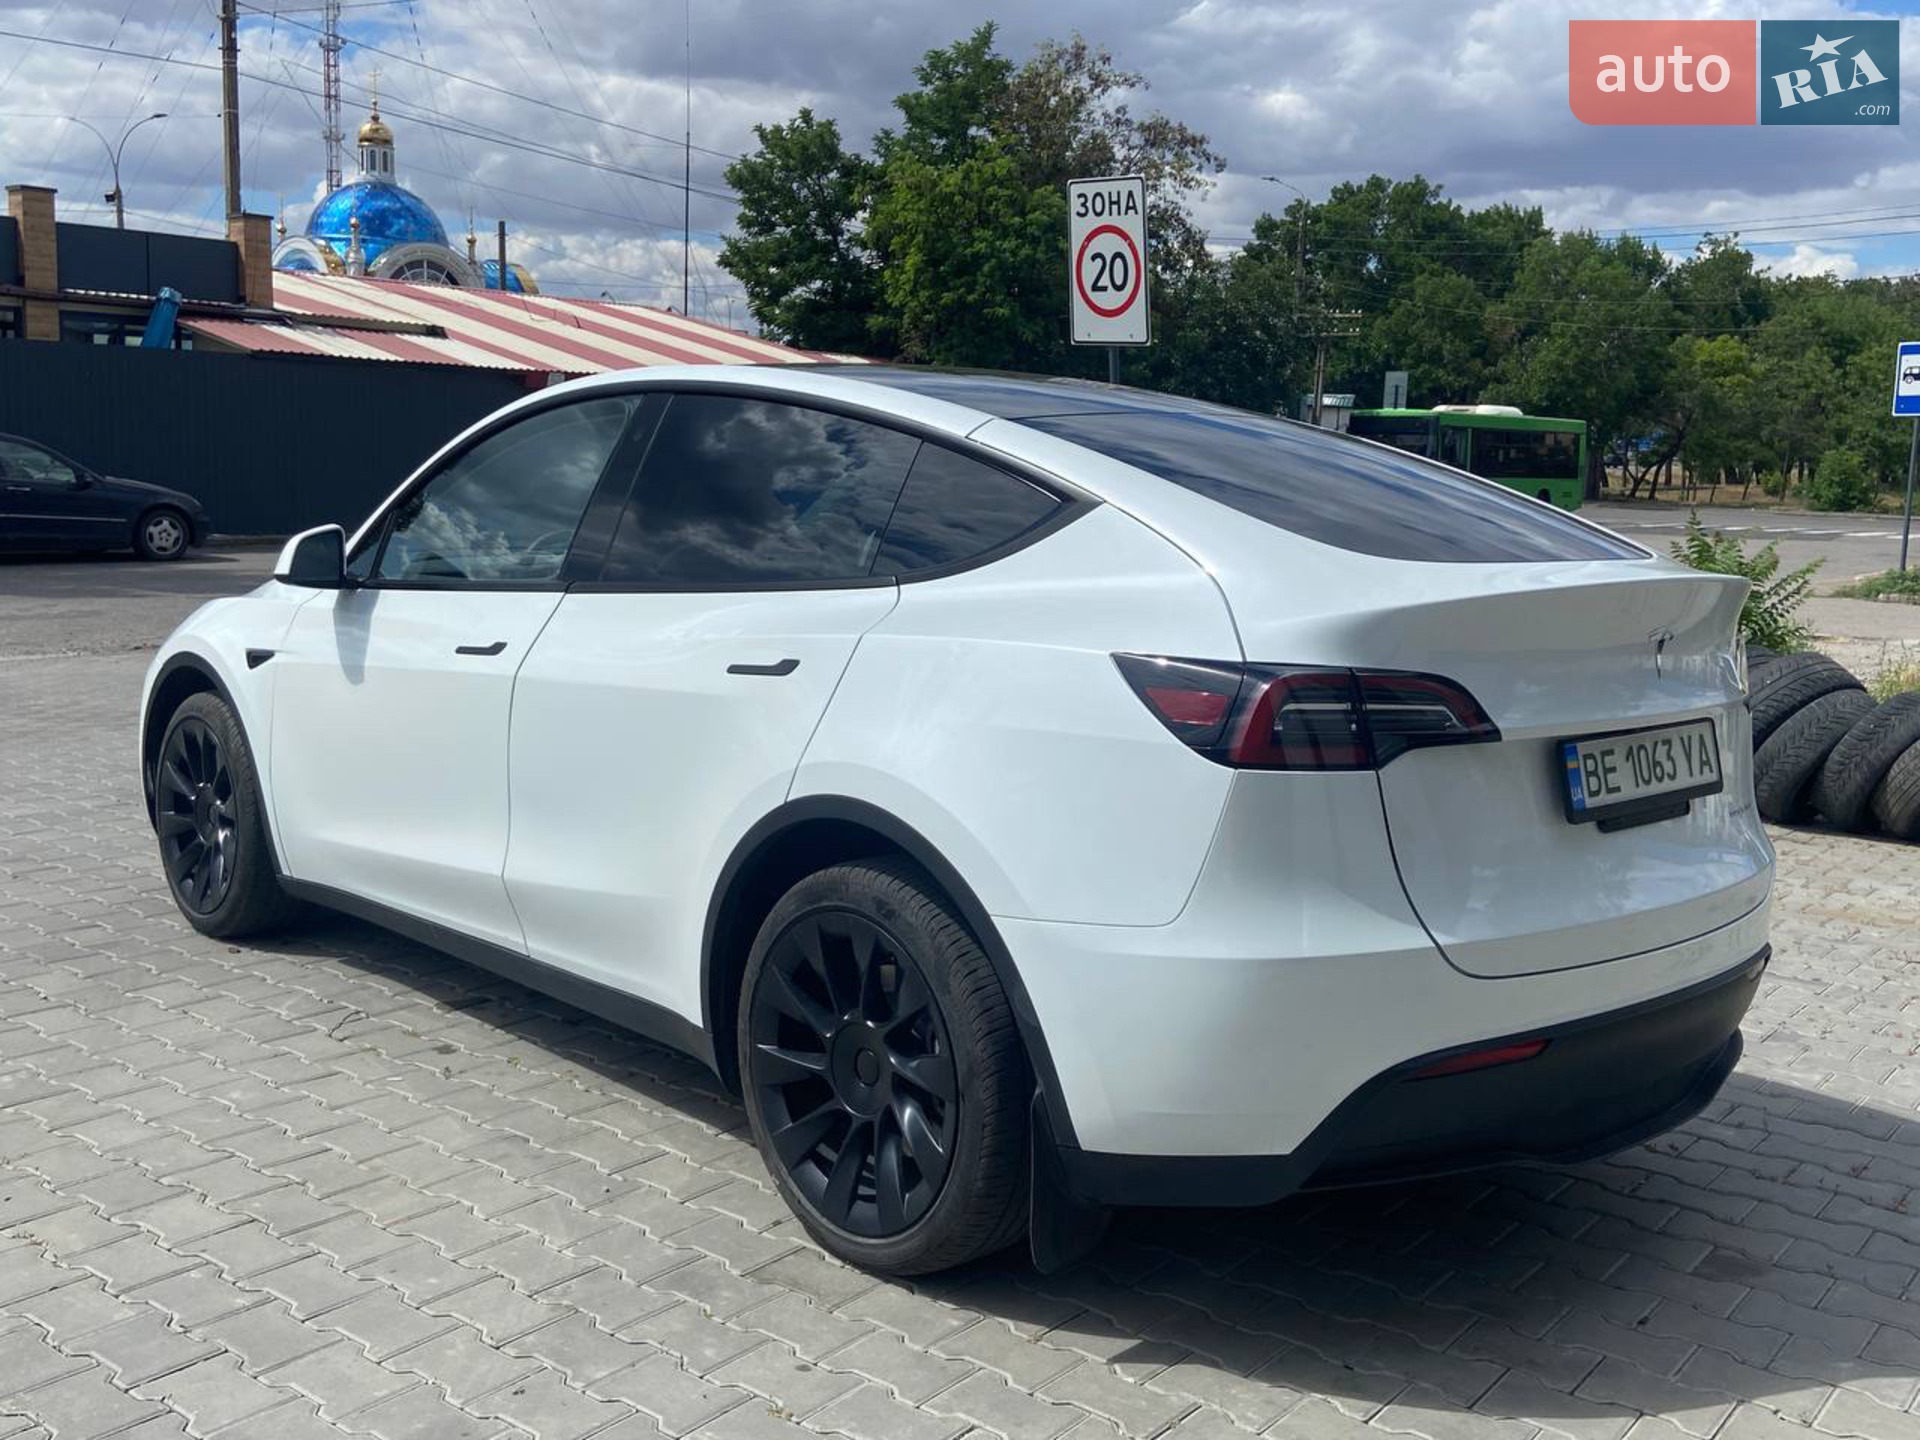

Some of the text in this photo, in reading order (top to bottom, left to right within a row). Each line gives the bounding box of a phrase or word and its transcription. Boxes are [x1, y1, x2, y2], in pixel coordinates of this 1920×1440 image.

[1076, 190, 1139, 218] ЗОНА
[1090, 251, 1129, 292] 20
[1583, 733, 1714, 798] BE 1063 YA
